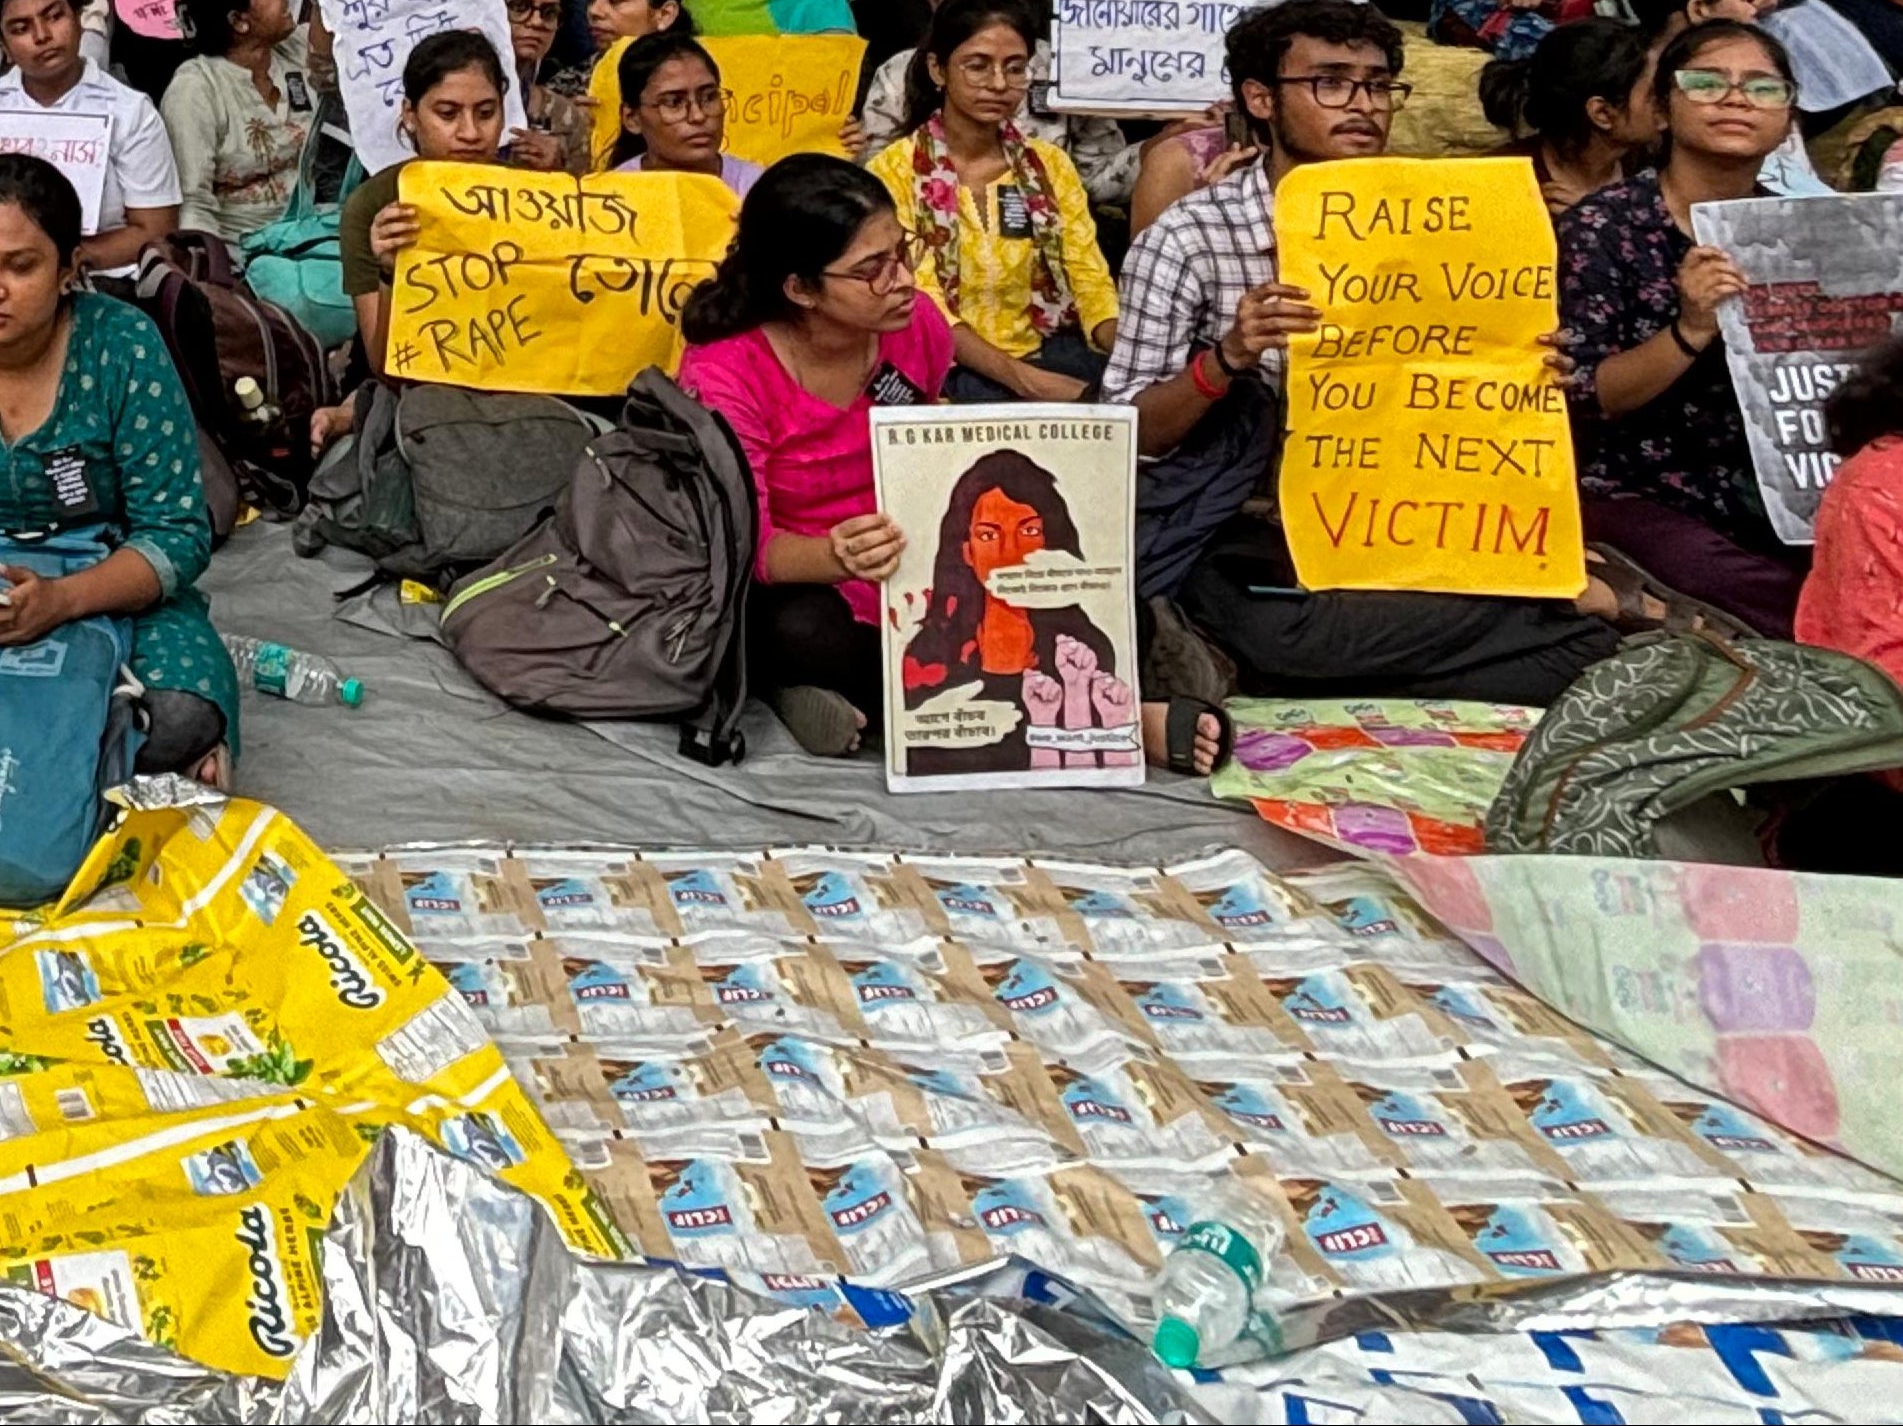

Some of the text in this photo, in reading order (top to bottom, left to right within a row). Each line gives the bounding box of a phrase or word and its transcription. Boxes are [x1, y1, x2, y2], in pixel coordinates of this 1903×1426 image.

[1314, 190, 1473, 242] RAISE
[405, 240, 526, 315] STOP
[1441, 261, 1553, 303] VOICE
[1308, 372, 1563, 415] YOU BECOME
[906, 426, 917, 446] G
[923, 425, 956, 444] KAR
[961, 423, 1033, 444] MEDICAL
[1039, 422, 1115, 442] COLLEGE
[1305, 432, 1556, 478] THE NEXT
[294, 913, 383, 1011] Ricola
[245, 1204, 298, 1360] Ricola
